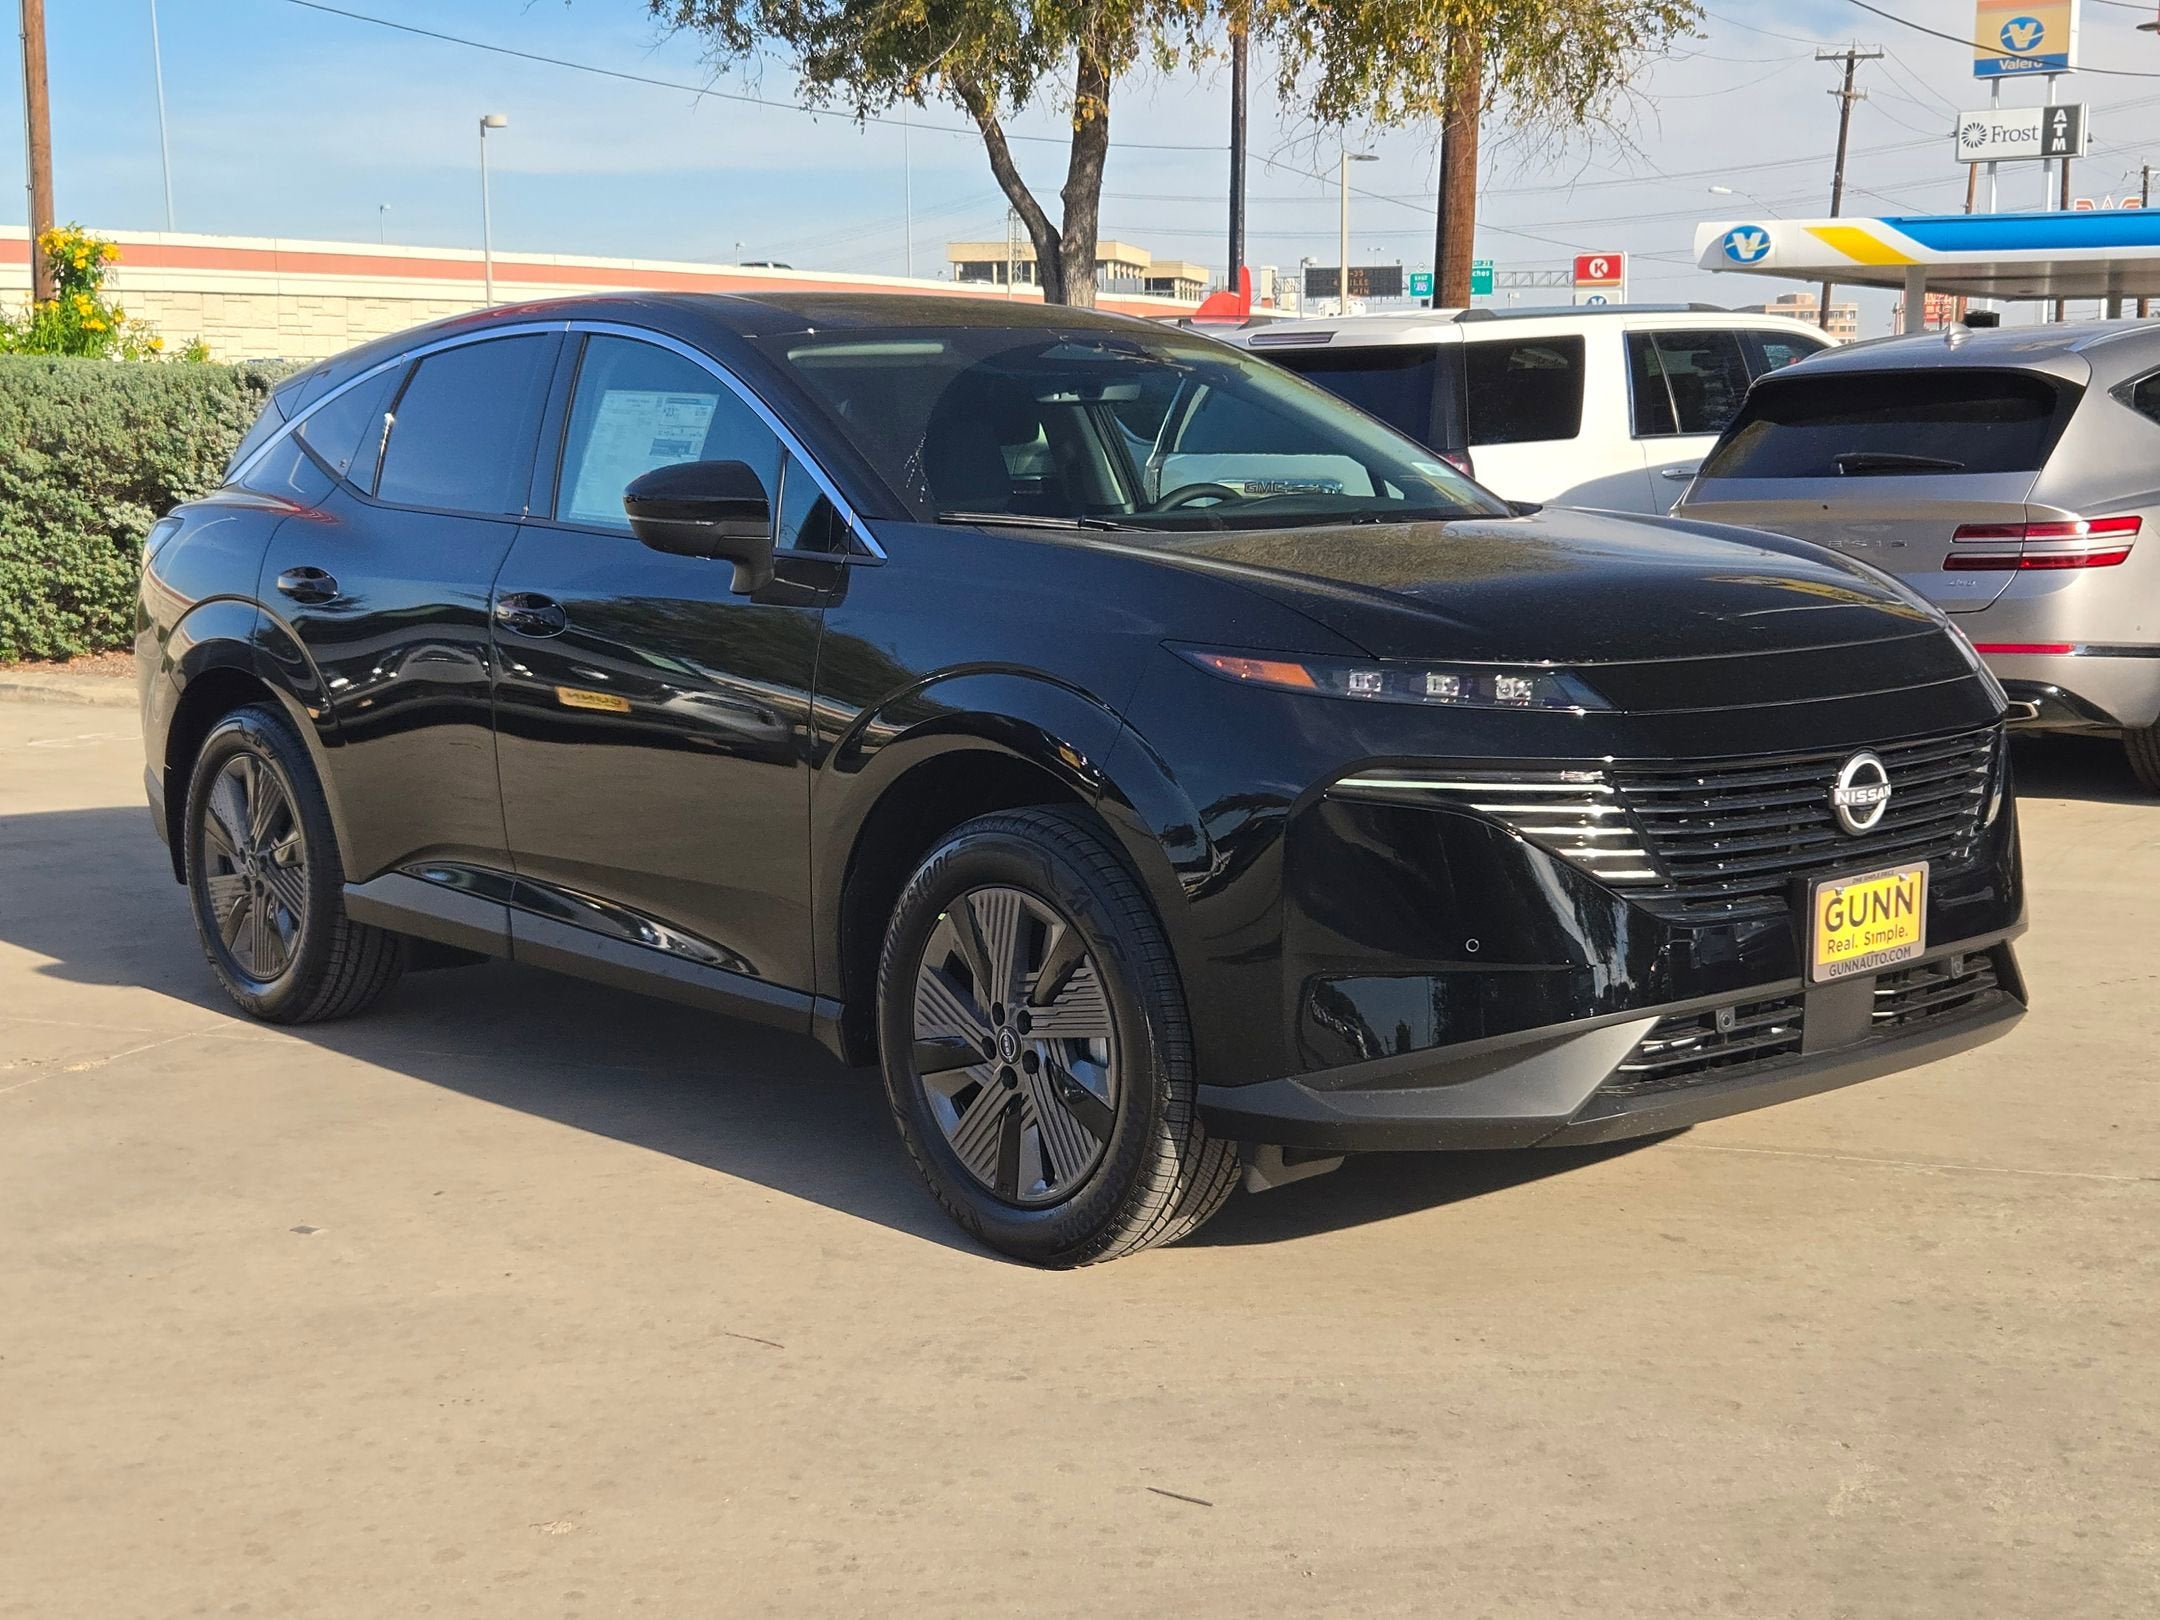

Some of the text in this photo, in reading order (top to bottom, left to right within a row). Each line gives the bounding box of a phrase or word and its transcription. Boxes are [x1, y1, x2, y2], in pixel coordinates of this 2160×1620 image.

[1991, 124, 2039, 143] Frost
[2052, 109, 2067, 151] ATM
[1244, 481, 1285, 494] GMC
[1835, 783, 1891, 804] NISSAN
[1825, 882, 1913, 932] GUNN
[1827, 924, 1908, 955] Real. Simple.
[1829, 946, 1912, 976] GUNNAUTO.COM
